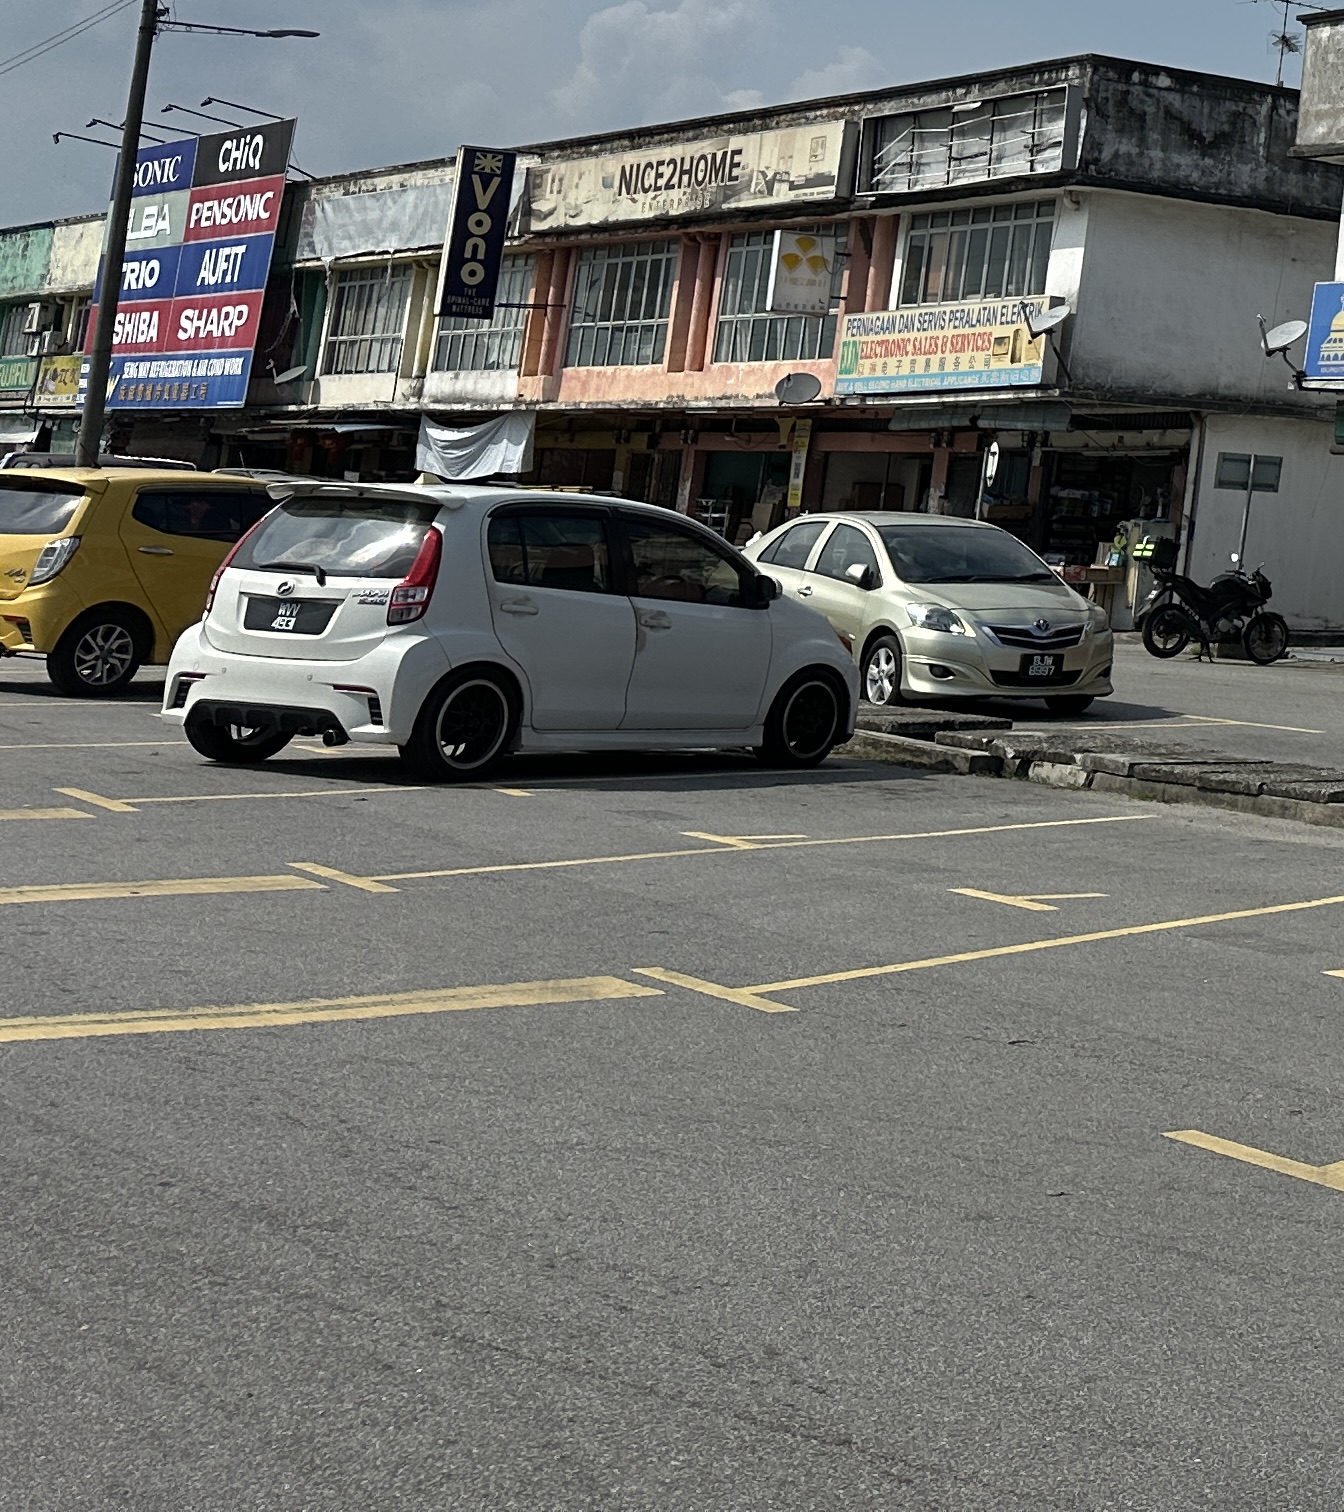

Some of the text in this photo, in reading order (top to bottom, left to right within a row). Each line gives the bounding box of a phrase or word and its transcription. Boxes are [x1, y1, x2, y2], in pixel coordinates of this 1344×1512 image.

[132, 155, 182, 188] SONIC
[617, 148, 743, 197] NICE2HOME
[127, 203, 171, 240] LBA
[189, 191, 275, 229] PENSONIC
[460, 174, 502, 286] Vono
[196, 244, 248, 287] AUFIT
[112, 311, 160, 345] SHIBA
[177, 304, 249, 341] SHARP
[451, 304, 483, 316] MATTRESS
[846, 315, 898, 338] PERNIAGAAN
[898, 313, 918, 334] DAN
[917, 309, 947, 333] SERVIS
[947, 305, 1000, 330] PERALATAN
[860, 332, 993, 360] ELECTRONIC SALES & SERVICES
